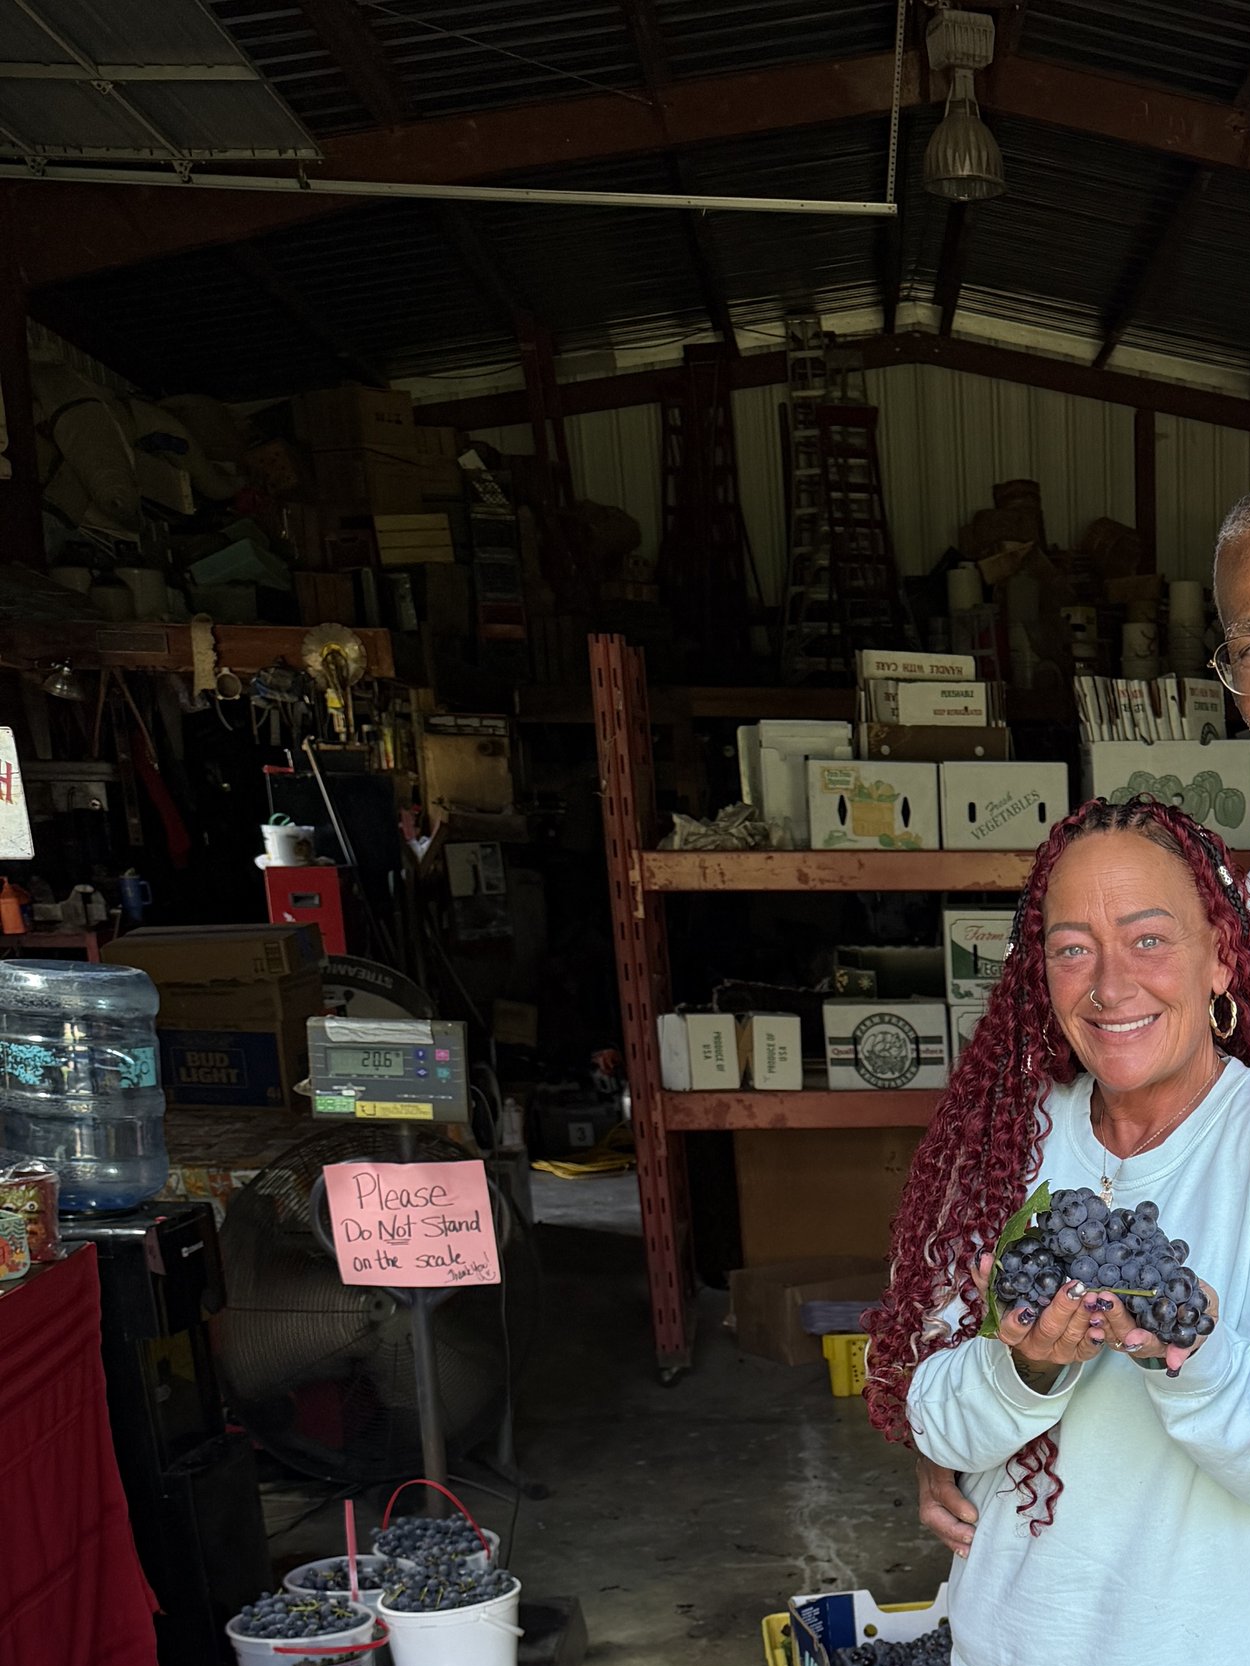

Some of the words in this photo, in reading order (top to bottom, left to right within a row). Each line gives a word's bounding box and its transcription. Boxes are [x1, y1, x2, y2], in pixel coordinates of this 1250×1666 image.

[971, 790, 1040, 841] VEGETABLES
[183, 1050, 230, 1067] BUD
[179, 1066, 240, 1084] LIGHT
[352, 1172, 455, 1211] Please
[341, 1218, 372, 1242] Do
[378, 1214, 417, 1242] Not
[421, 1210, 482, 1238] Stand
[353, 1256, 372, 1272] on
[376, 1249, 403, 1270] the
[416, 1244, 466, 1269] scale
